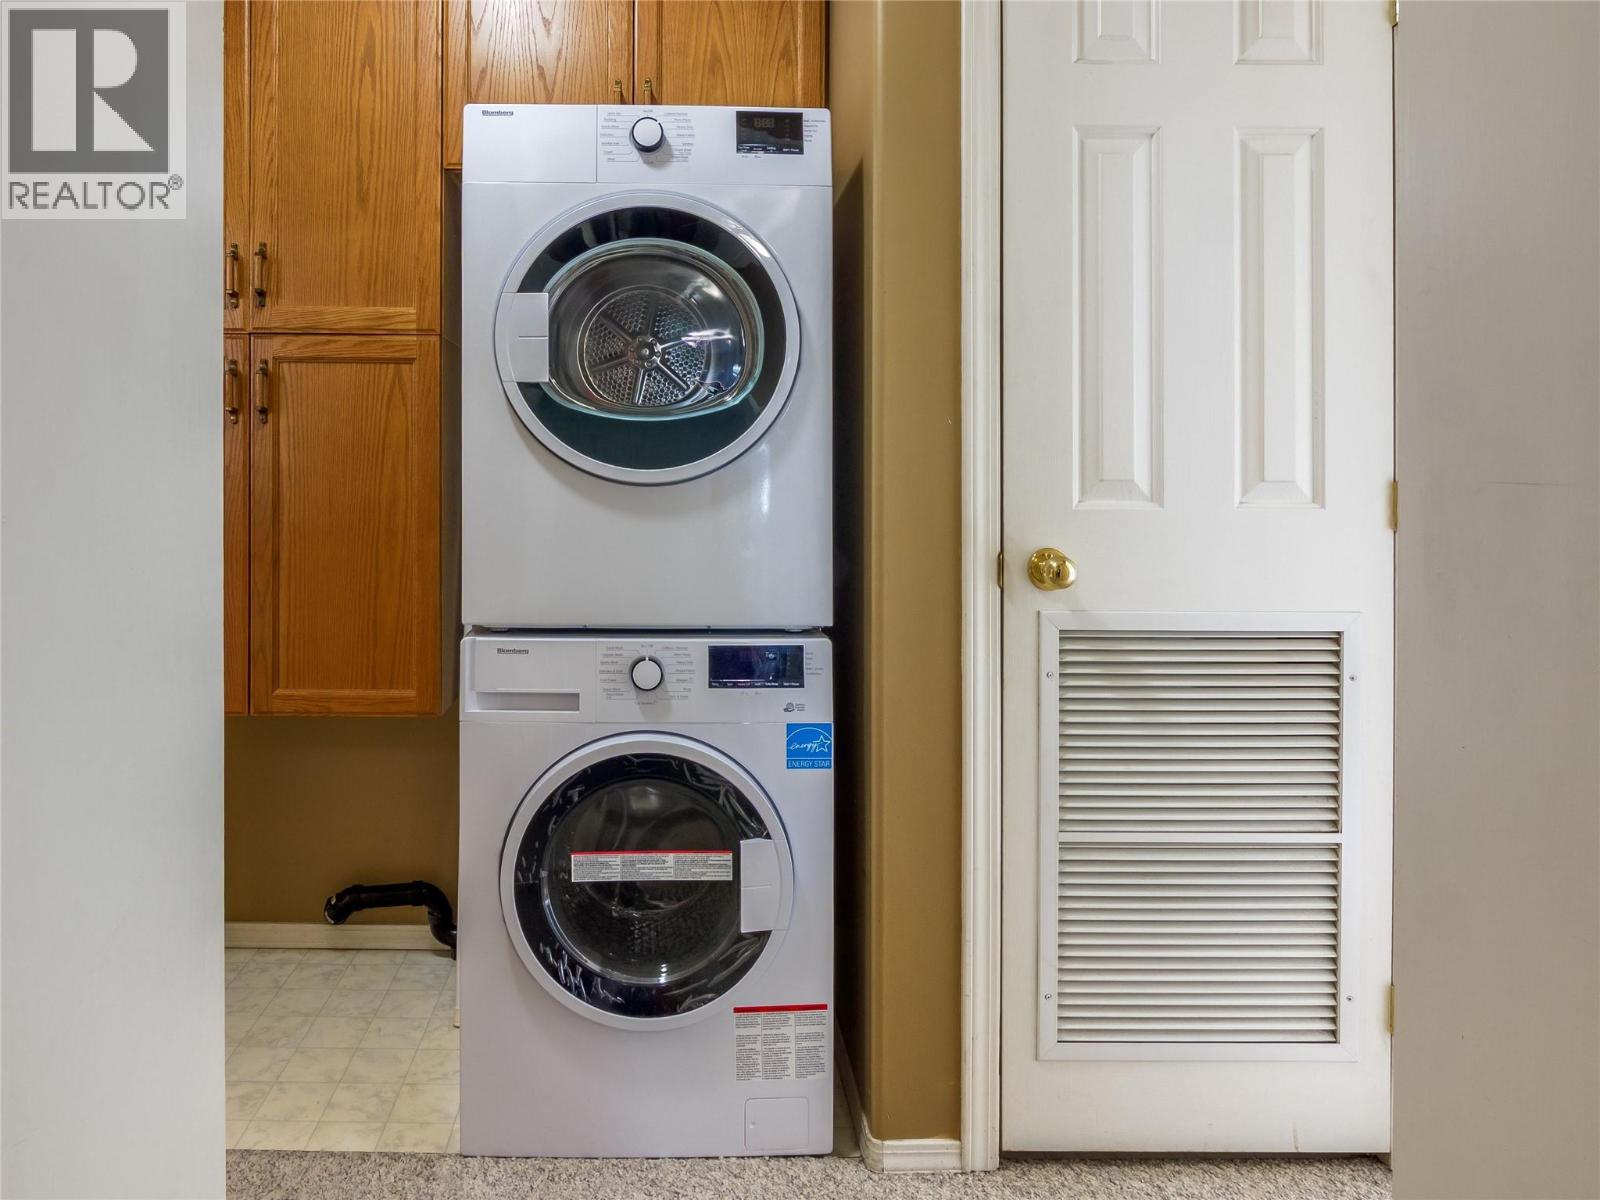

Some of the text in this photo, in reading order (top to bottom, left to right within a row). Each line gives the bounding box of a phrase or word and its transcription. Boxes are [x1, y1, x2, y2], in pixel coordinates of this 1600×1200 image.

[496, 647, 530, 655] Blomberg
[788, 760, 831, 768] ENERGY STAR
